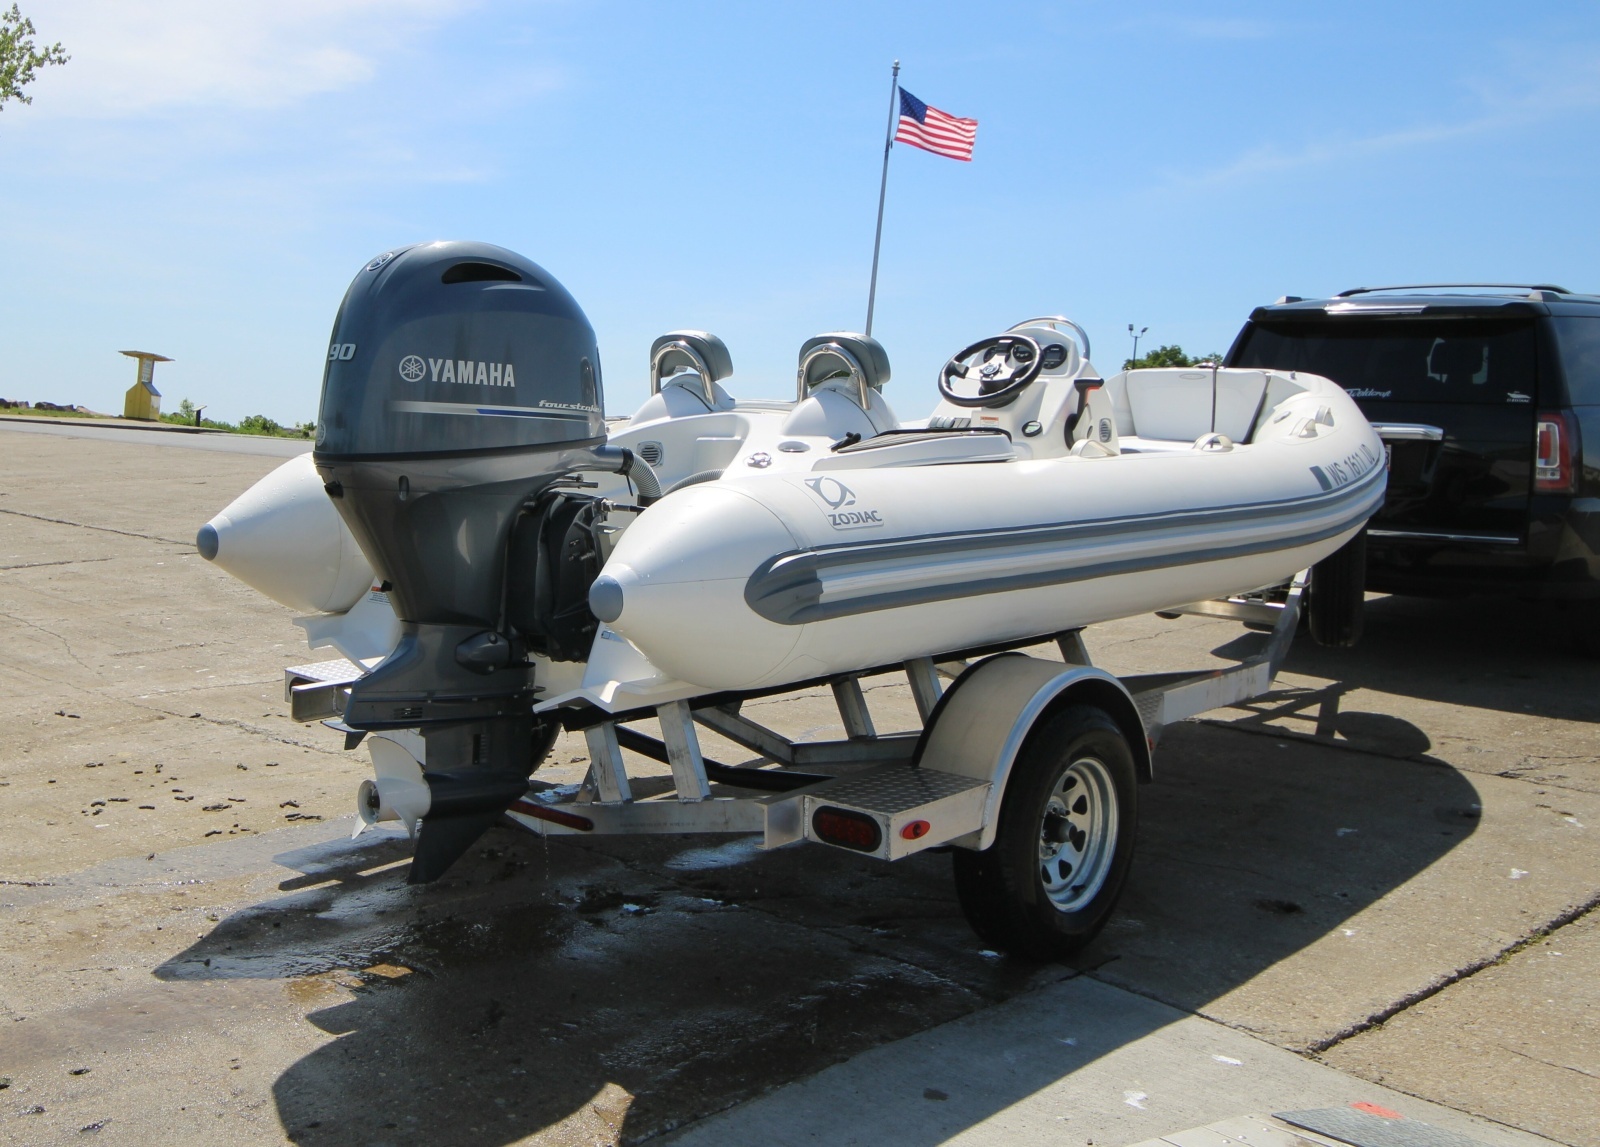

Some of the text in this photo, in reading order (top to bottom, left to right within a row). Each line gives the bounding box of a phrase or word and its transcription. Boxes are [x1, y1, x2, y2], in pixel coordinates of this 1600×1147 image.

[328, 343, 357, 361] 90
[428, 358, 515, 387] YAMAHA
[1325, 461, 1348, 486] WS
[1343, 452, 1368, 478] 1611
[828, 510, 883, 526] ZODIAC
